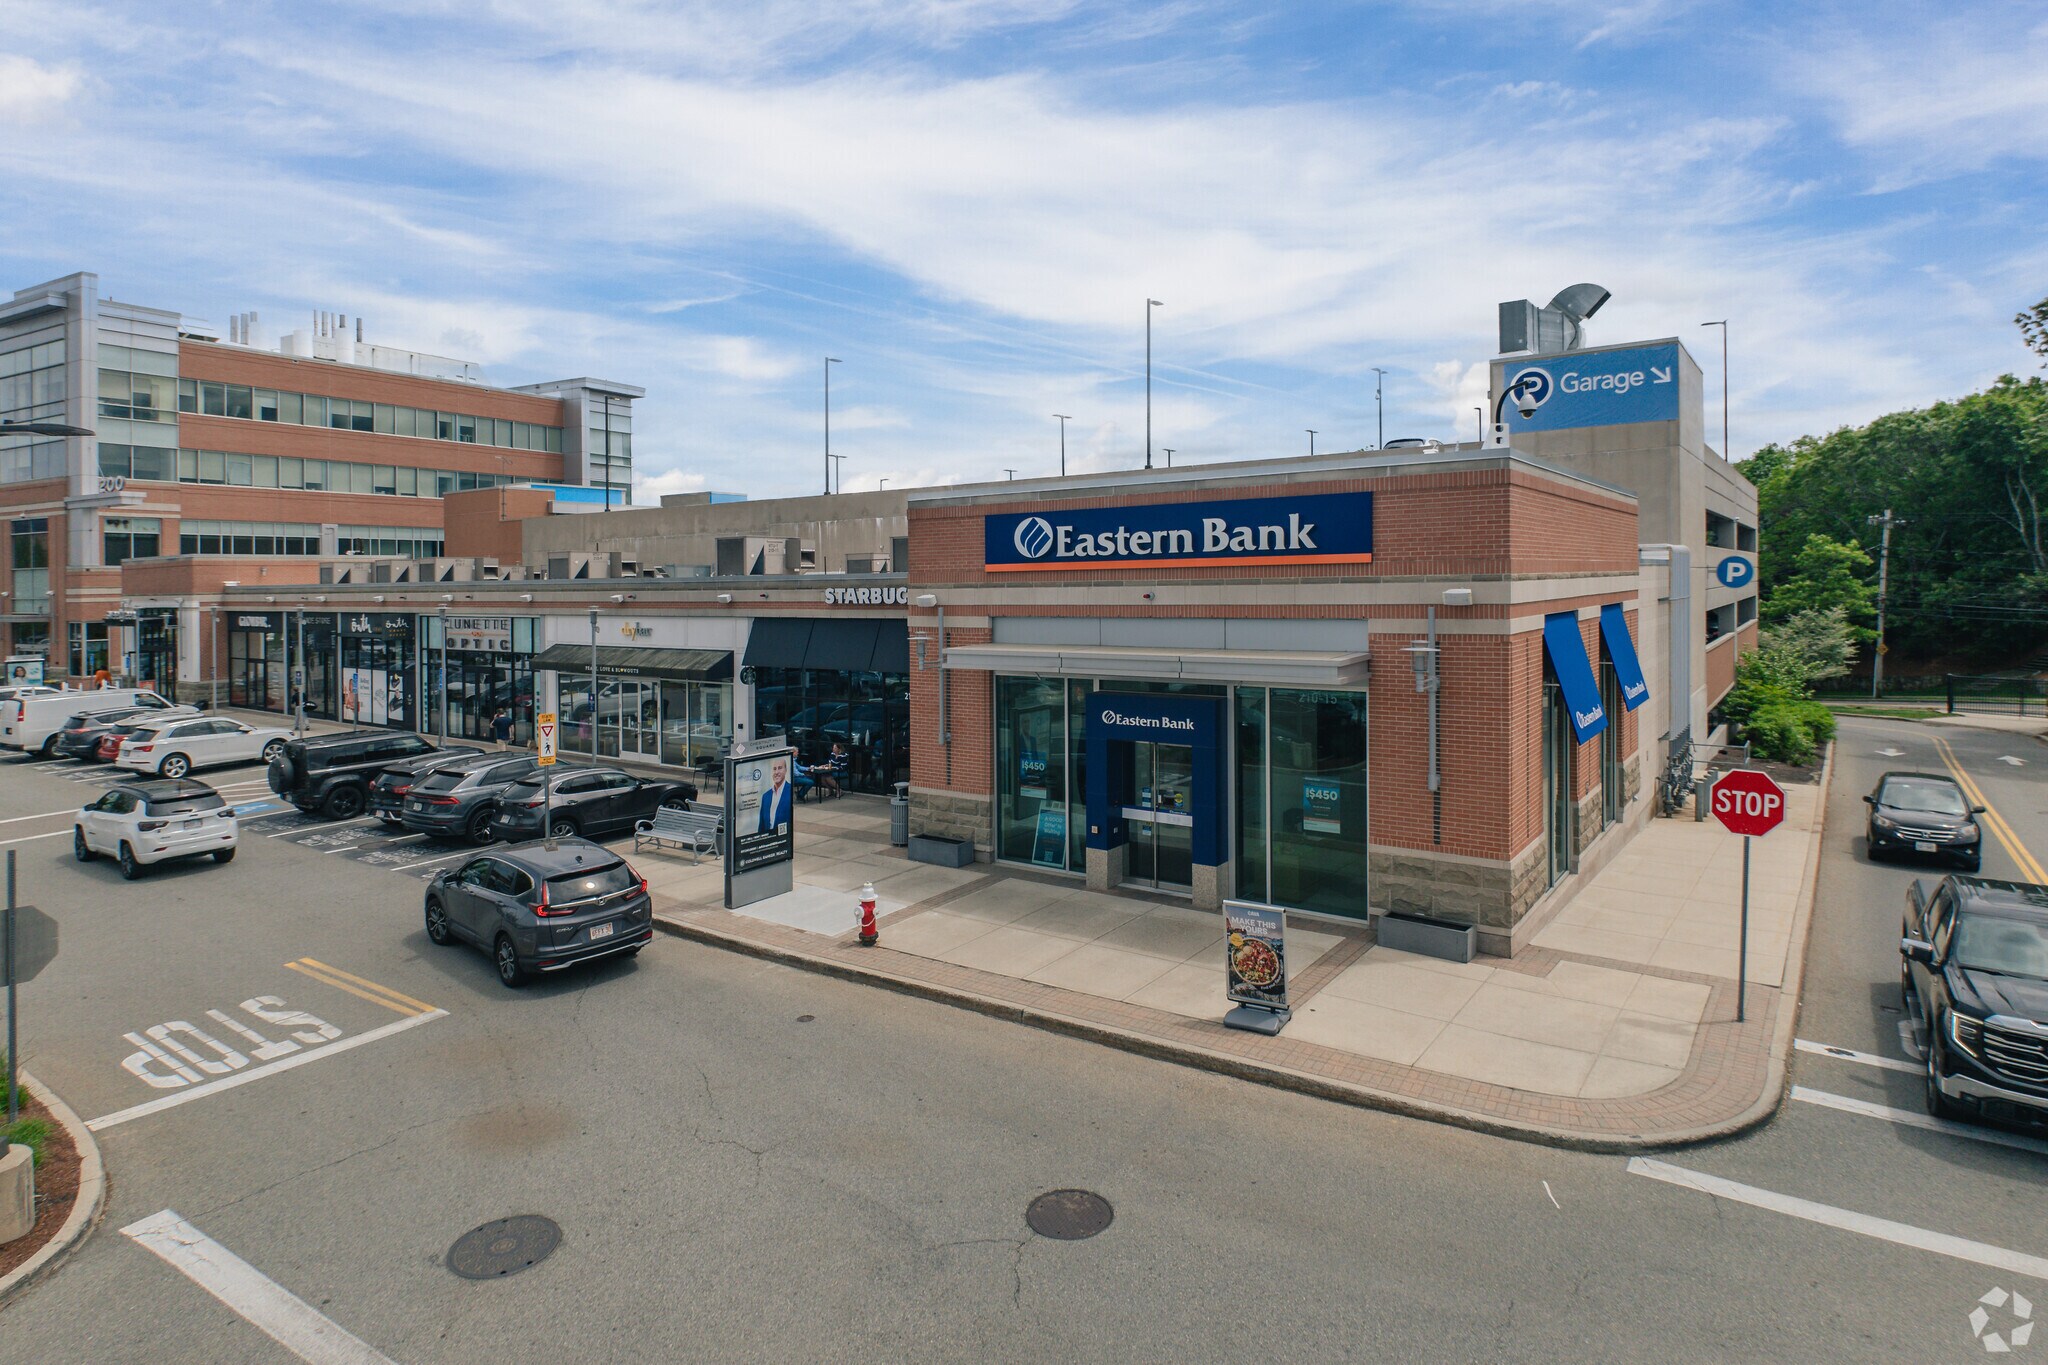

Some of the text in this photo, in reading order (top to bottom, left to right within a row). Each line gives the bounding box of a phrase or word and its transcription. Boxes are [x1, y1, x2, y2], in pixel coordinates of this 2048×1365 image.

[1560, 371, 1645, 394] Garage
[98, 476, 125, 493] 200
[1055, 512, 1318, 558] Eastern Bank
[1726, 562, 1746, 582] P
[446, 637, 511, 650] OPTIC
[1116, 714, 1195, 730] Eastern Bank
[756, 743, 776, 751] SQUARE
[1715, 788, 1780, 818] STOP
[1231, 916, 1277, 930] MAKE THIS
[1240, 924, 1268, 935] YOURS
[121, 995, 343, 1088] STOP
